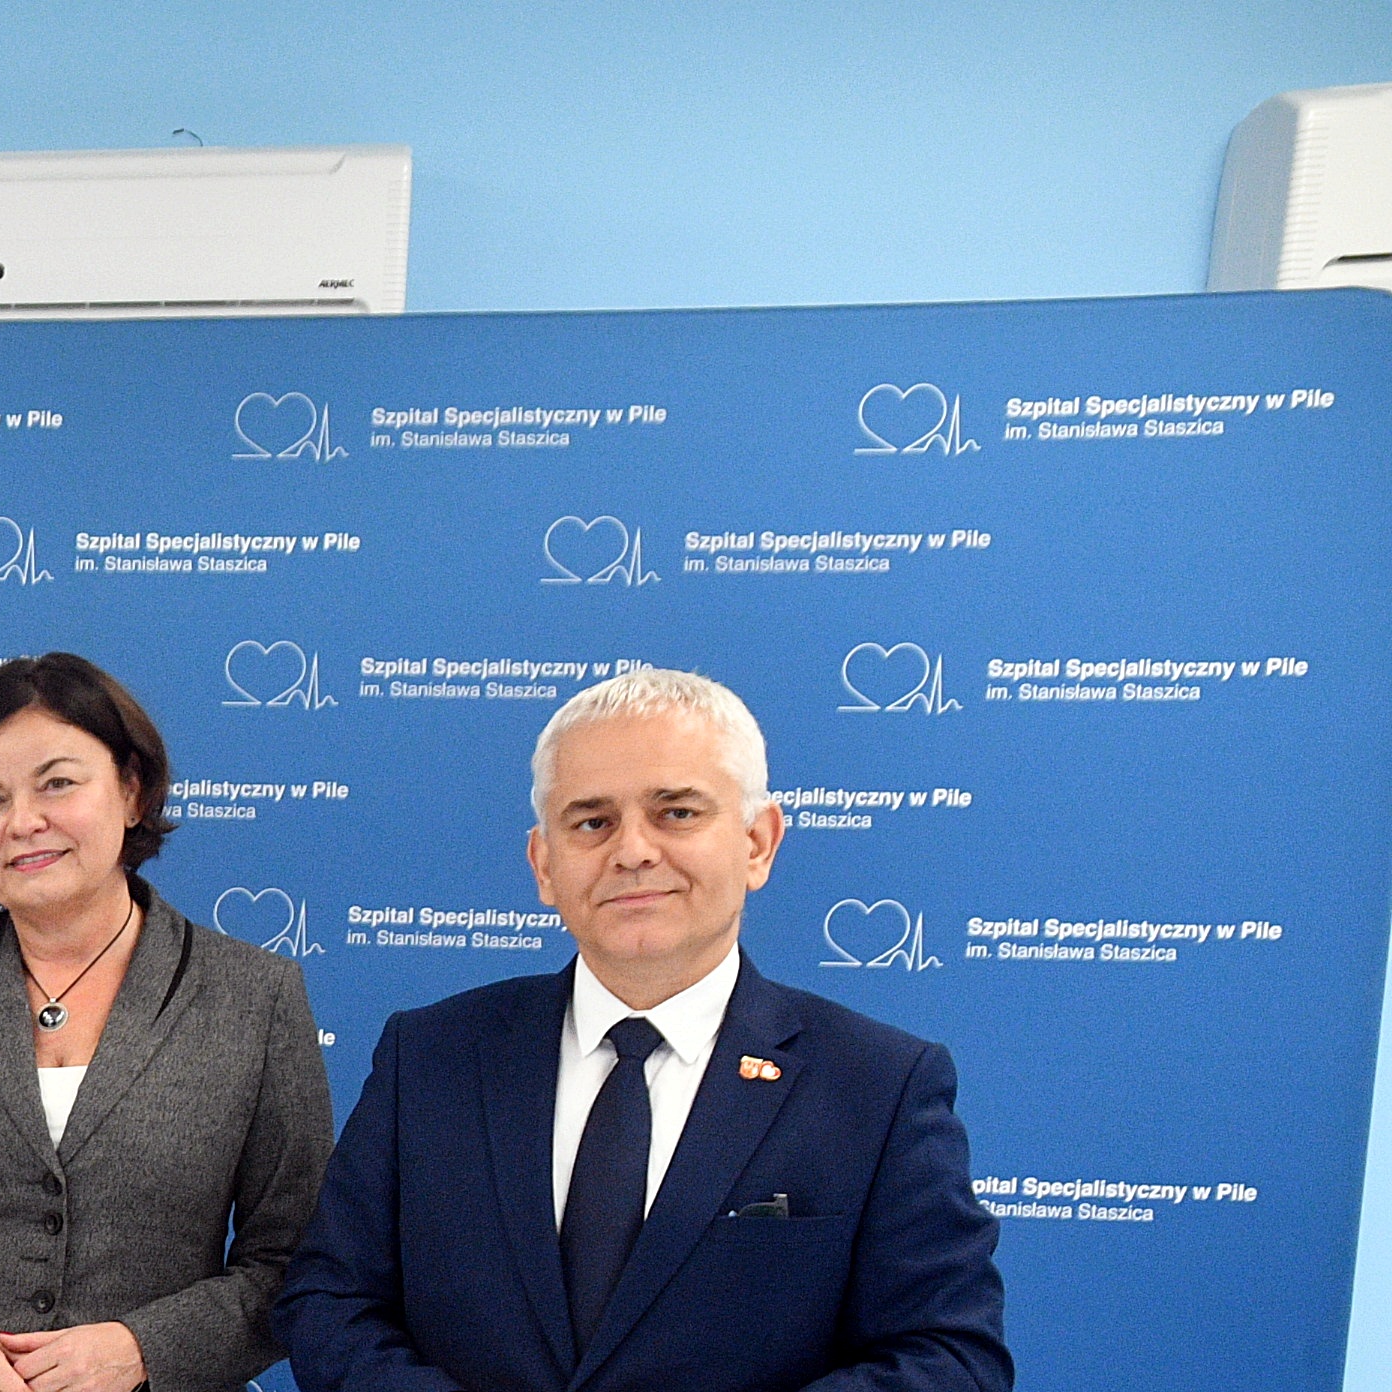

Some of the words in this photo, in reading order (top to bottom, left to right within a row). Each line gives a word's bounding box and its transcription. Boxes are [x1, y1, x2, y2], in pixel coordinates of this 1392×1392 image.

[1006, 396, 1081, 421] Szpital
[1085, 393, 1260, 419] Specjalistyczny
[1265, 394, 1286, 410] w
[1290, 388, 1335, 409] Pile
[6, 414, 22, 428] w
[26, 410, 63, 428] Pile
[372, 407, 439, 429] Szpital
[444, 406, 601, 429] Specjalistyczny
[606, 409, 624, 424] w
[627, 404, 667, 424] Pile
[401, 431, 493, 448] Stanisława
[497, 430, 570, 447] Staszica
[1038, 421, 1139, 440] Stanisława
[1143, 419, 1224, 437] Staszica
[76, 532, 141, 554] Szpital
[145, 532, 297, 555] Specjalistyczny
[301, 536, 319, 551] w
[323, 532, 361, 551] Pile
[685, 531, 755, 554] Szpital
[759, 531, 923, 554] Specjalistyczny
[927, 534, 946, 549] w
[950, 529, 992, 549] Pile
[104, 555, 193, 572] Stanisława
[197, 555, 267, 572] Staszica
[715, 555, 810, 572] Stanisława
[815, 555, 890, 572] Staszica
[361, 657, 426, 678] Szpital
[432, 658, 588, 680] Specjalistyczny
[593, 662, 610, 677] w
[987, 658, 1061, 682] Szpital
[1065, 658, 1236, 682] Specjalistyczny
[1240, 661, 1261, 677] w
[1265, 657, 1309, 677] Pile
[391, 682, 480, 697] Stanisława
[486, 682, 552, 698] Staszica
[1018, 683, 1117, 701] Stanisława
[1122, 682, 1201, 701] Staszica
[312, 781, 349, 799] Pile
[931, 788, 972, 807] Pile
[187, 802, 256, 819] Staszica
[798, 811, 873, 829] Staszica
[348, 905, 414, 928] Szpital
[377, 929, 467, 947] Stanisława
[471, 932, 542, 949] Staszica
[967, 917, 1039, 940] Szpital
[1044, 918, 1212, 944] Specjalistyczny
[1216, 924, 1236, 939] w
[1239, 921, 1283, 941] Pile
[997, 942, 1095, 960] Stanisława
[1099, 943, 1177, 962] Staszica
[1021, 1177, 1188, 1204] Specjalistyczny
[1215, 1183, 1258, 1202] Pile
[1077, 1202, 1154, 1222] Staszica
